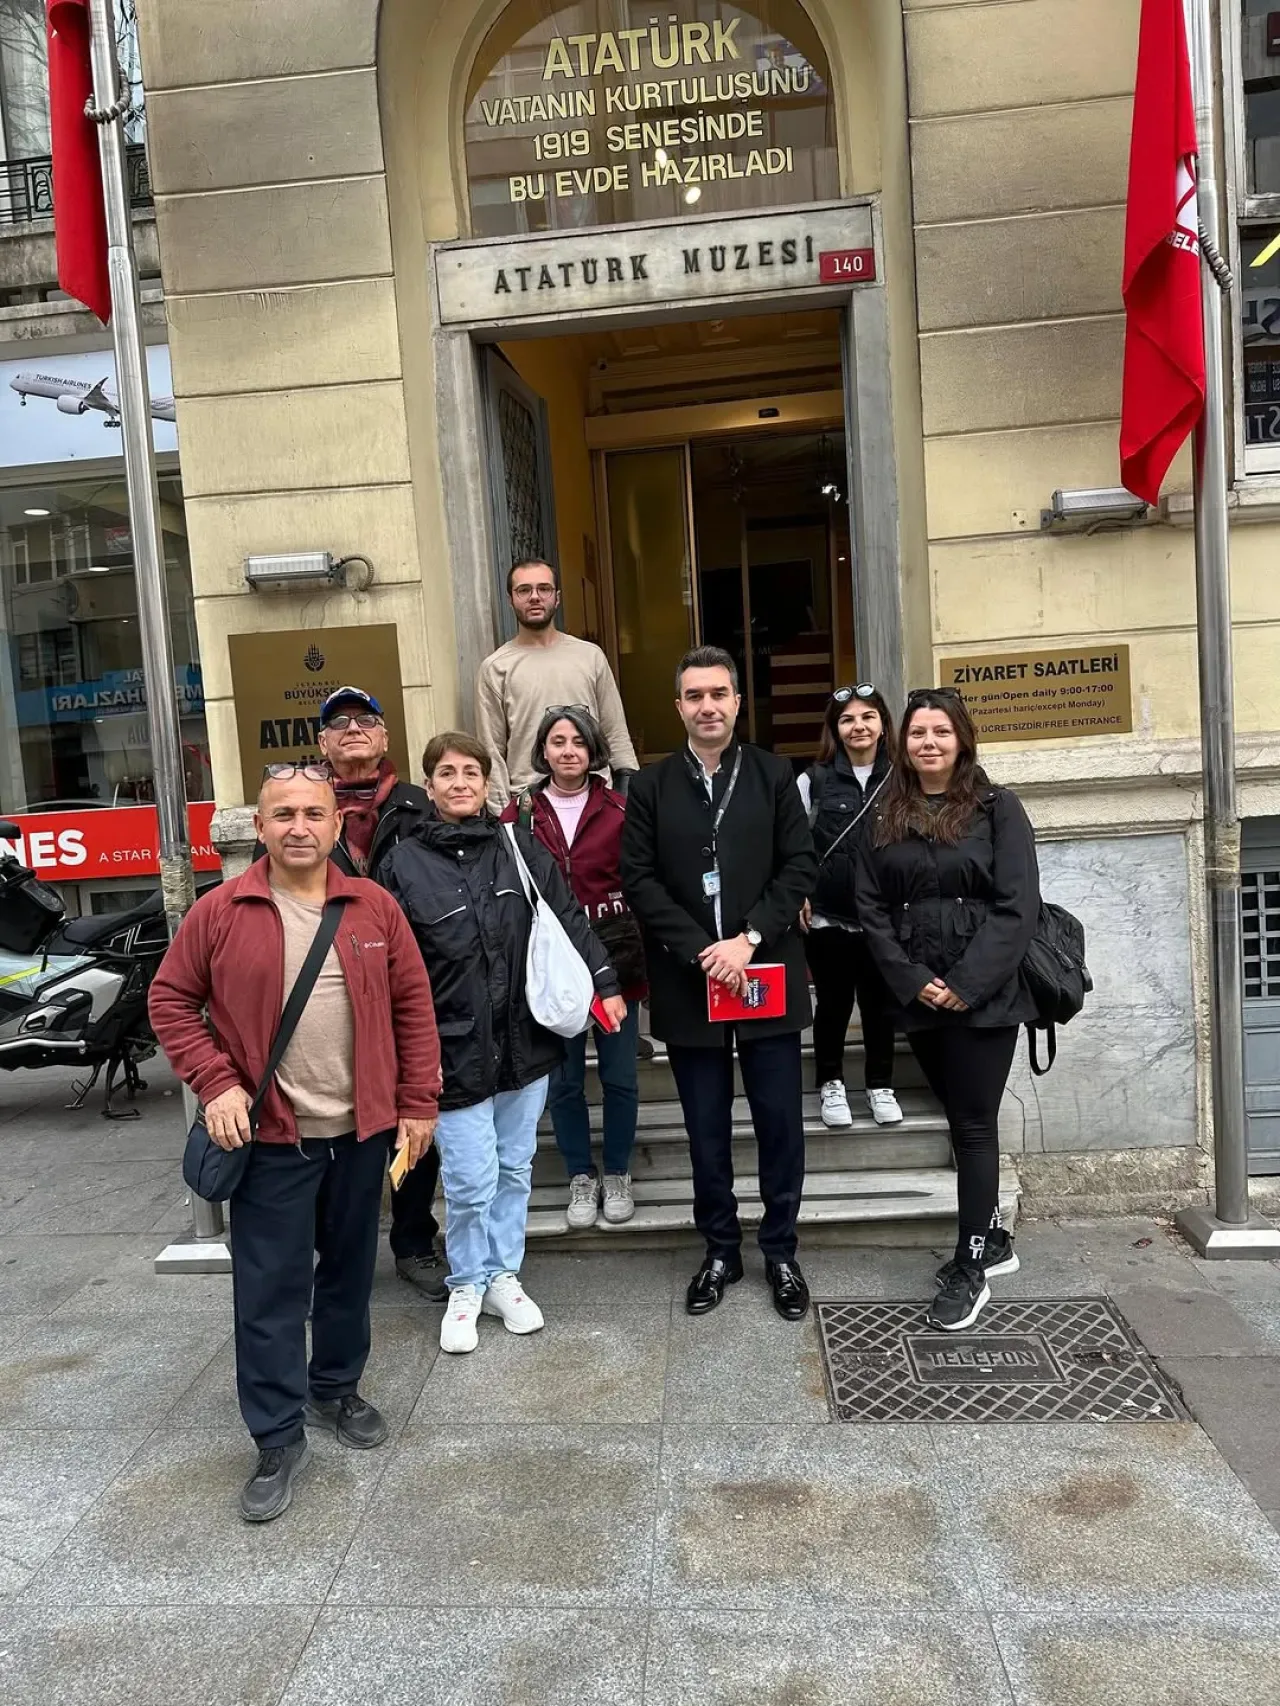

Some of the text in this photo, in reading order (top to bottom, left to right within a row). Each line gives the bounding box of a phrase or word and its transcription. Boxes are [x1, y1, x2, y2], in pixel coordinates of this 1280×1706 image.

[543, 14, 743, 81] ATATÜRK
[481, 66, 811, 127] VATANIN KURTULUŞUNU
[533, 109, 764, 160] 1919 SENESİNDE
[509, 146, 795, 202] BU EVDE HAZIRLADI
[494, 235, 815, 295] ATATÜRK MÜZESİ
[833, 256, 863, 274] 140
[36, 373, 92, 389] TURKISH AIRLINES
[953, 653, 1119, 684] ZİYARET SAATLERİ
[1034, 688, 1057, 700] daily
[1060, 684, 1114, 696] 9:00-17:00
[969, 705, 1011, 717] (Pazartesi
[1068, 699, 1106, 710] Monday)
[1072, 715, 1122, 728] ENTRANCE
[99, 854, 109, 863] A
[113, 849, 151, 863] STAR
[928, 1351, 1039, 1368] TELEFON
